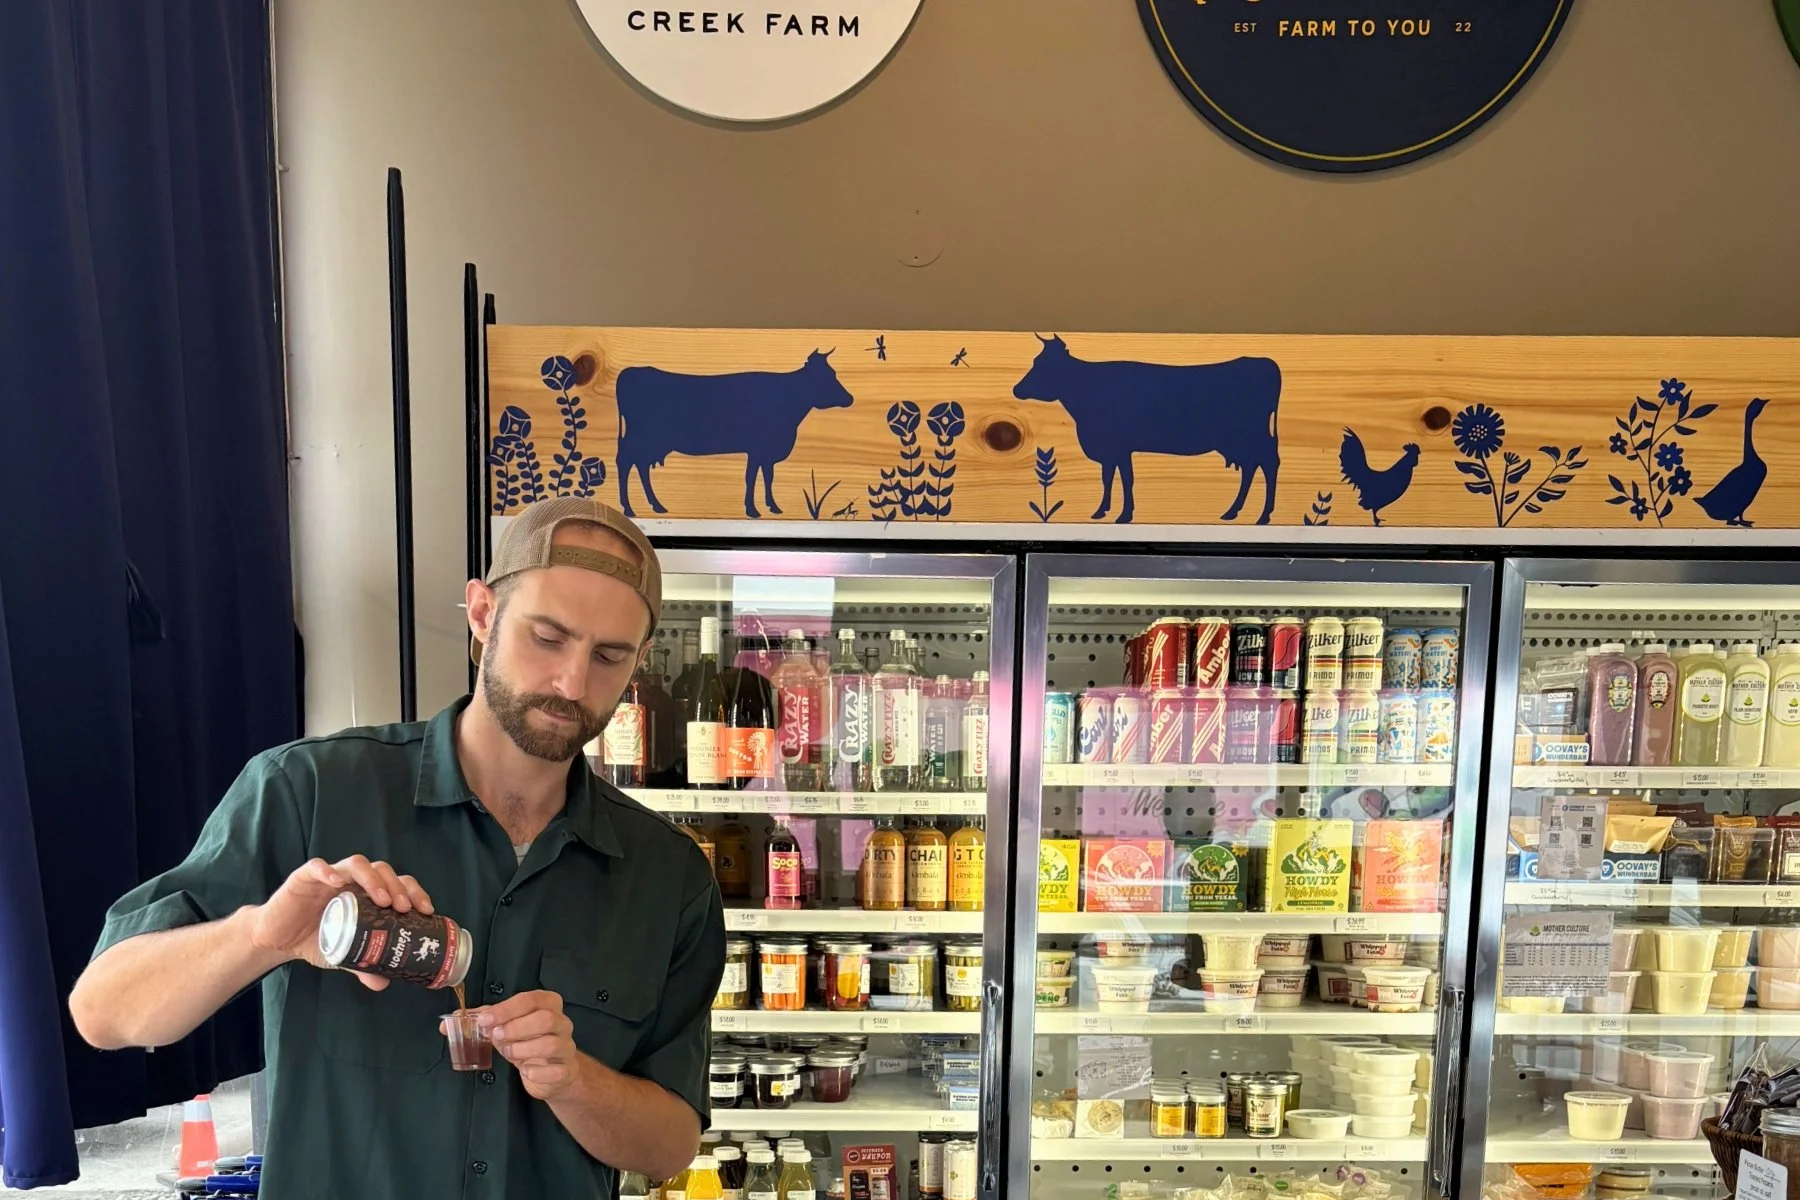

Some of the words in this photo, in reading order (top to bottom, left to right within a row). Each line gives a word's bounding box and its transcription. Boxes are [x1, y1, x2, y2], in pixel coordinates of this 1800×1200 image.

[627, 10, 745, 34] CREEK
[766, 13, 859, 37] FARM
[1234, 22, 1257, 33] EST
[1279, 20, 1336, 37] FARM
[1348, 20, 1376, 36] TO
[1387, 19, 1431, 36] YOU
[1455, 22, 1472, 33] 22
[1308, 633, 1343, 649] Zilker
[1346, 632, 1381, 650] Zilker
[1346, 671, 1374, 680] PRIMOS
[779, 686, 804, 764] CRAZY
[801, 696, 810, 745] WATER
[839, 684, 862, 763] CRAZY
[859, 694, 869, 745] WATER
[881, 720, 896, 765] CRAZY
[1545, 744, 1588, 754] OOVAY'S
[1545, 753, 1588, 761] WUNDERBAR
[864, 849, 897, 861] DRTY
[910, 849, 942, 861] CHAI
[1617, 862, 1658, 872] OOVAY'S
[1285, 876, 1339, 886] HOWDY
[1617, 871, 1658, 879] WUNDERBAR
[1038, 884, 1068, 894] WDY
[1096, 884, 1153, 896] HOWDY
[1181, 884, 1237, 896] HOWDY
[1543, 924, 1564, 933] MOTHER
[1566, 924, 1590, 933] CULTURE
[389, 927, 412, 968] Yaupon
